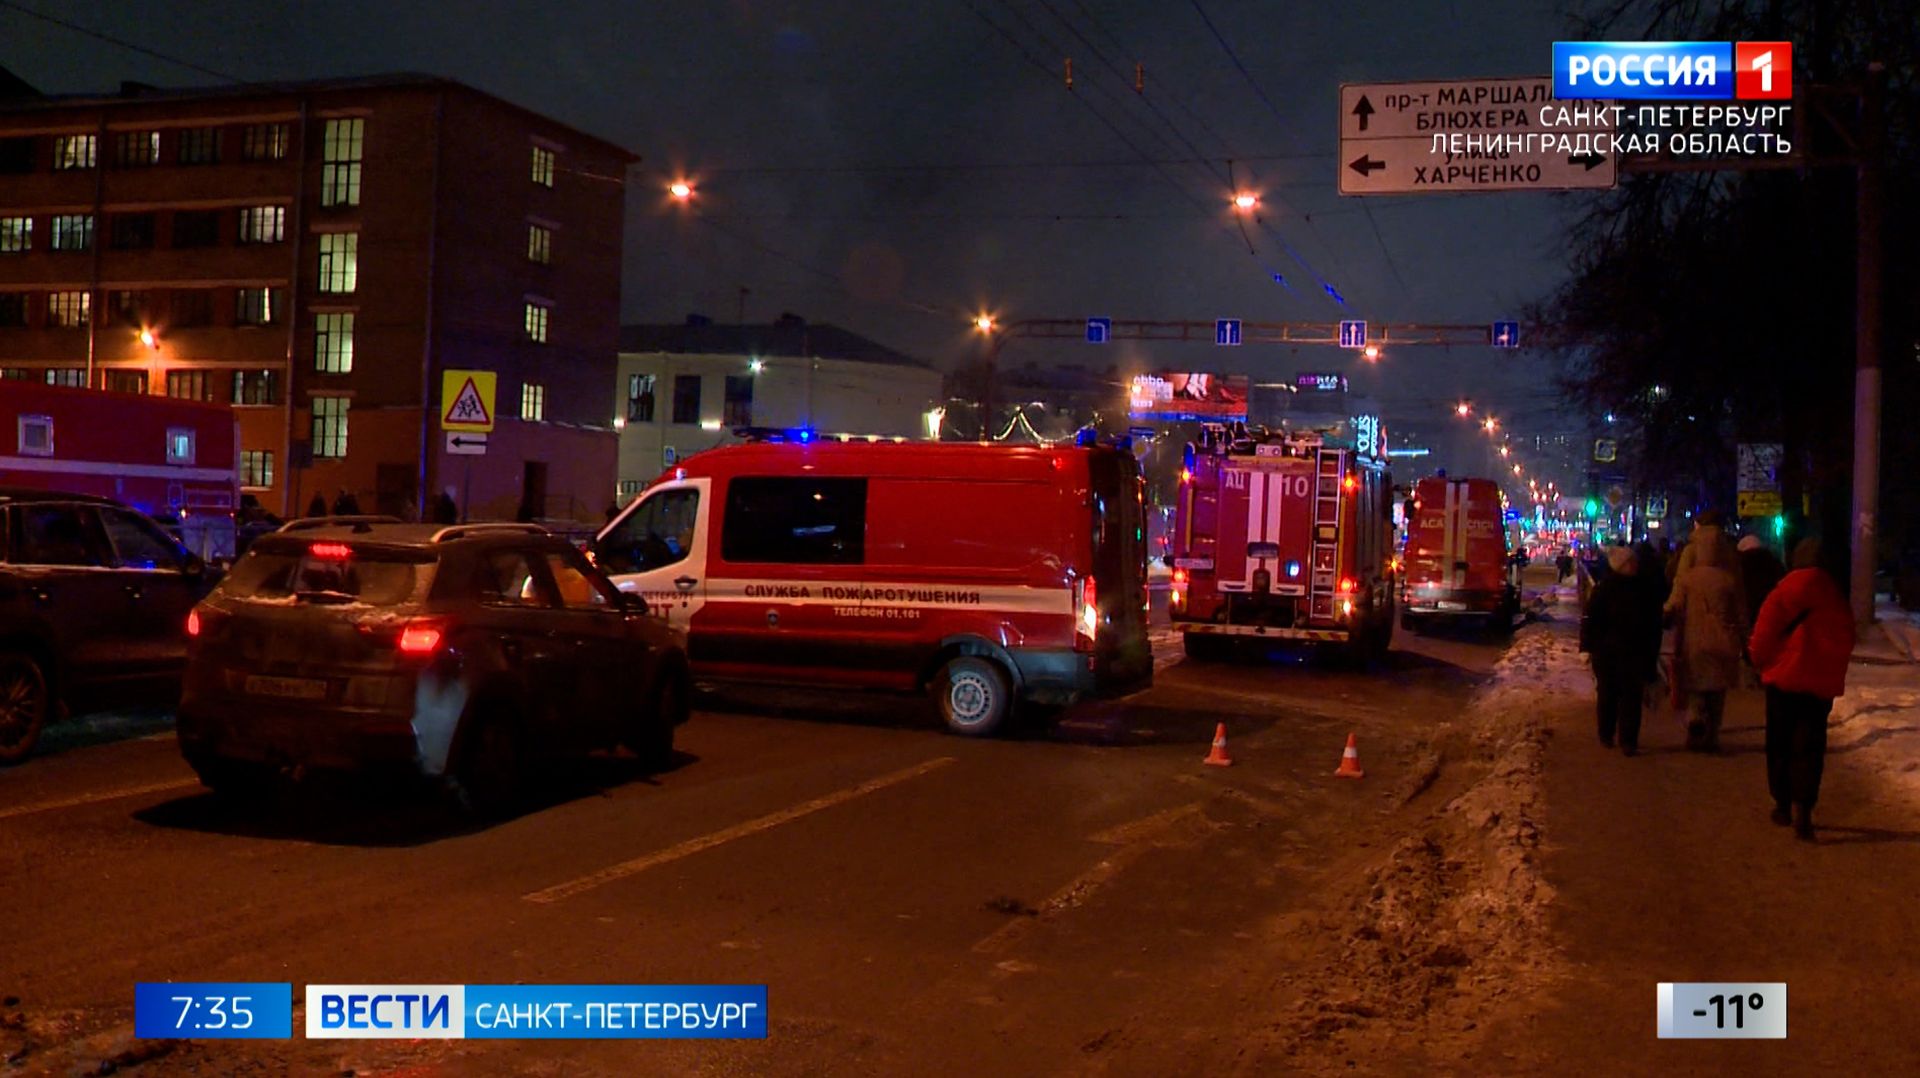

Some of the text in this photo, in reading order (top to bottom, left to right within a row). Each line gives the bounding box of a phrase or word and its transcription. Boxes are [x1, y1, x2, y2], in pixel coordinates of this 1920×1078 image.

[1385, 93, 1428, 112] пр-т
[1416, 109, 1530, 130] БЛЮХЕРА
[1414, 164, 1541, 185] ХАРЧЕНКО
[1282, 475, 1309, 498] 10
[745, 584, 980, 604] СЛУЖБА ПОЖАРОТУШЕНИЯ
[834, 606, 884, 618] ТЕЛЕФОН
